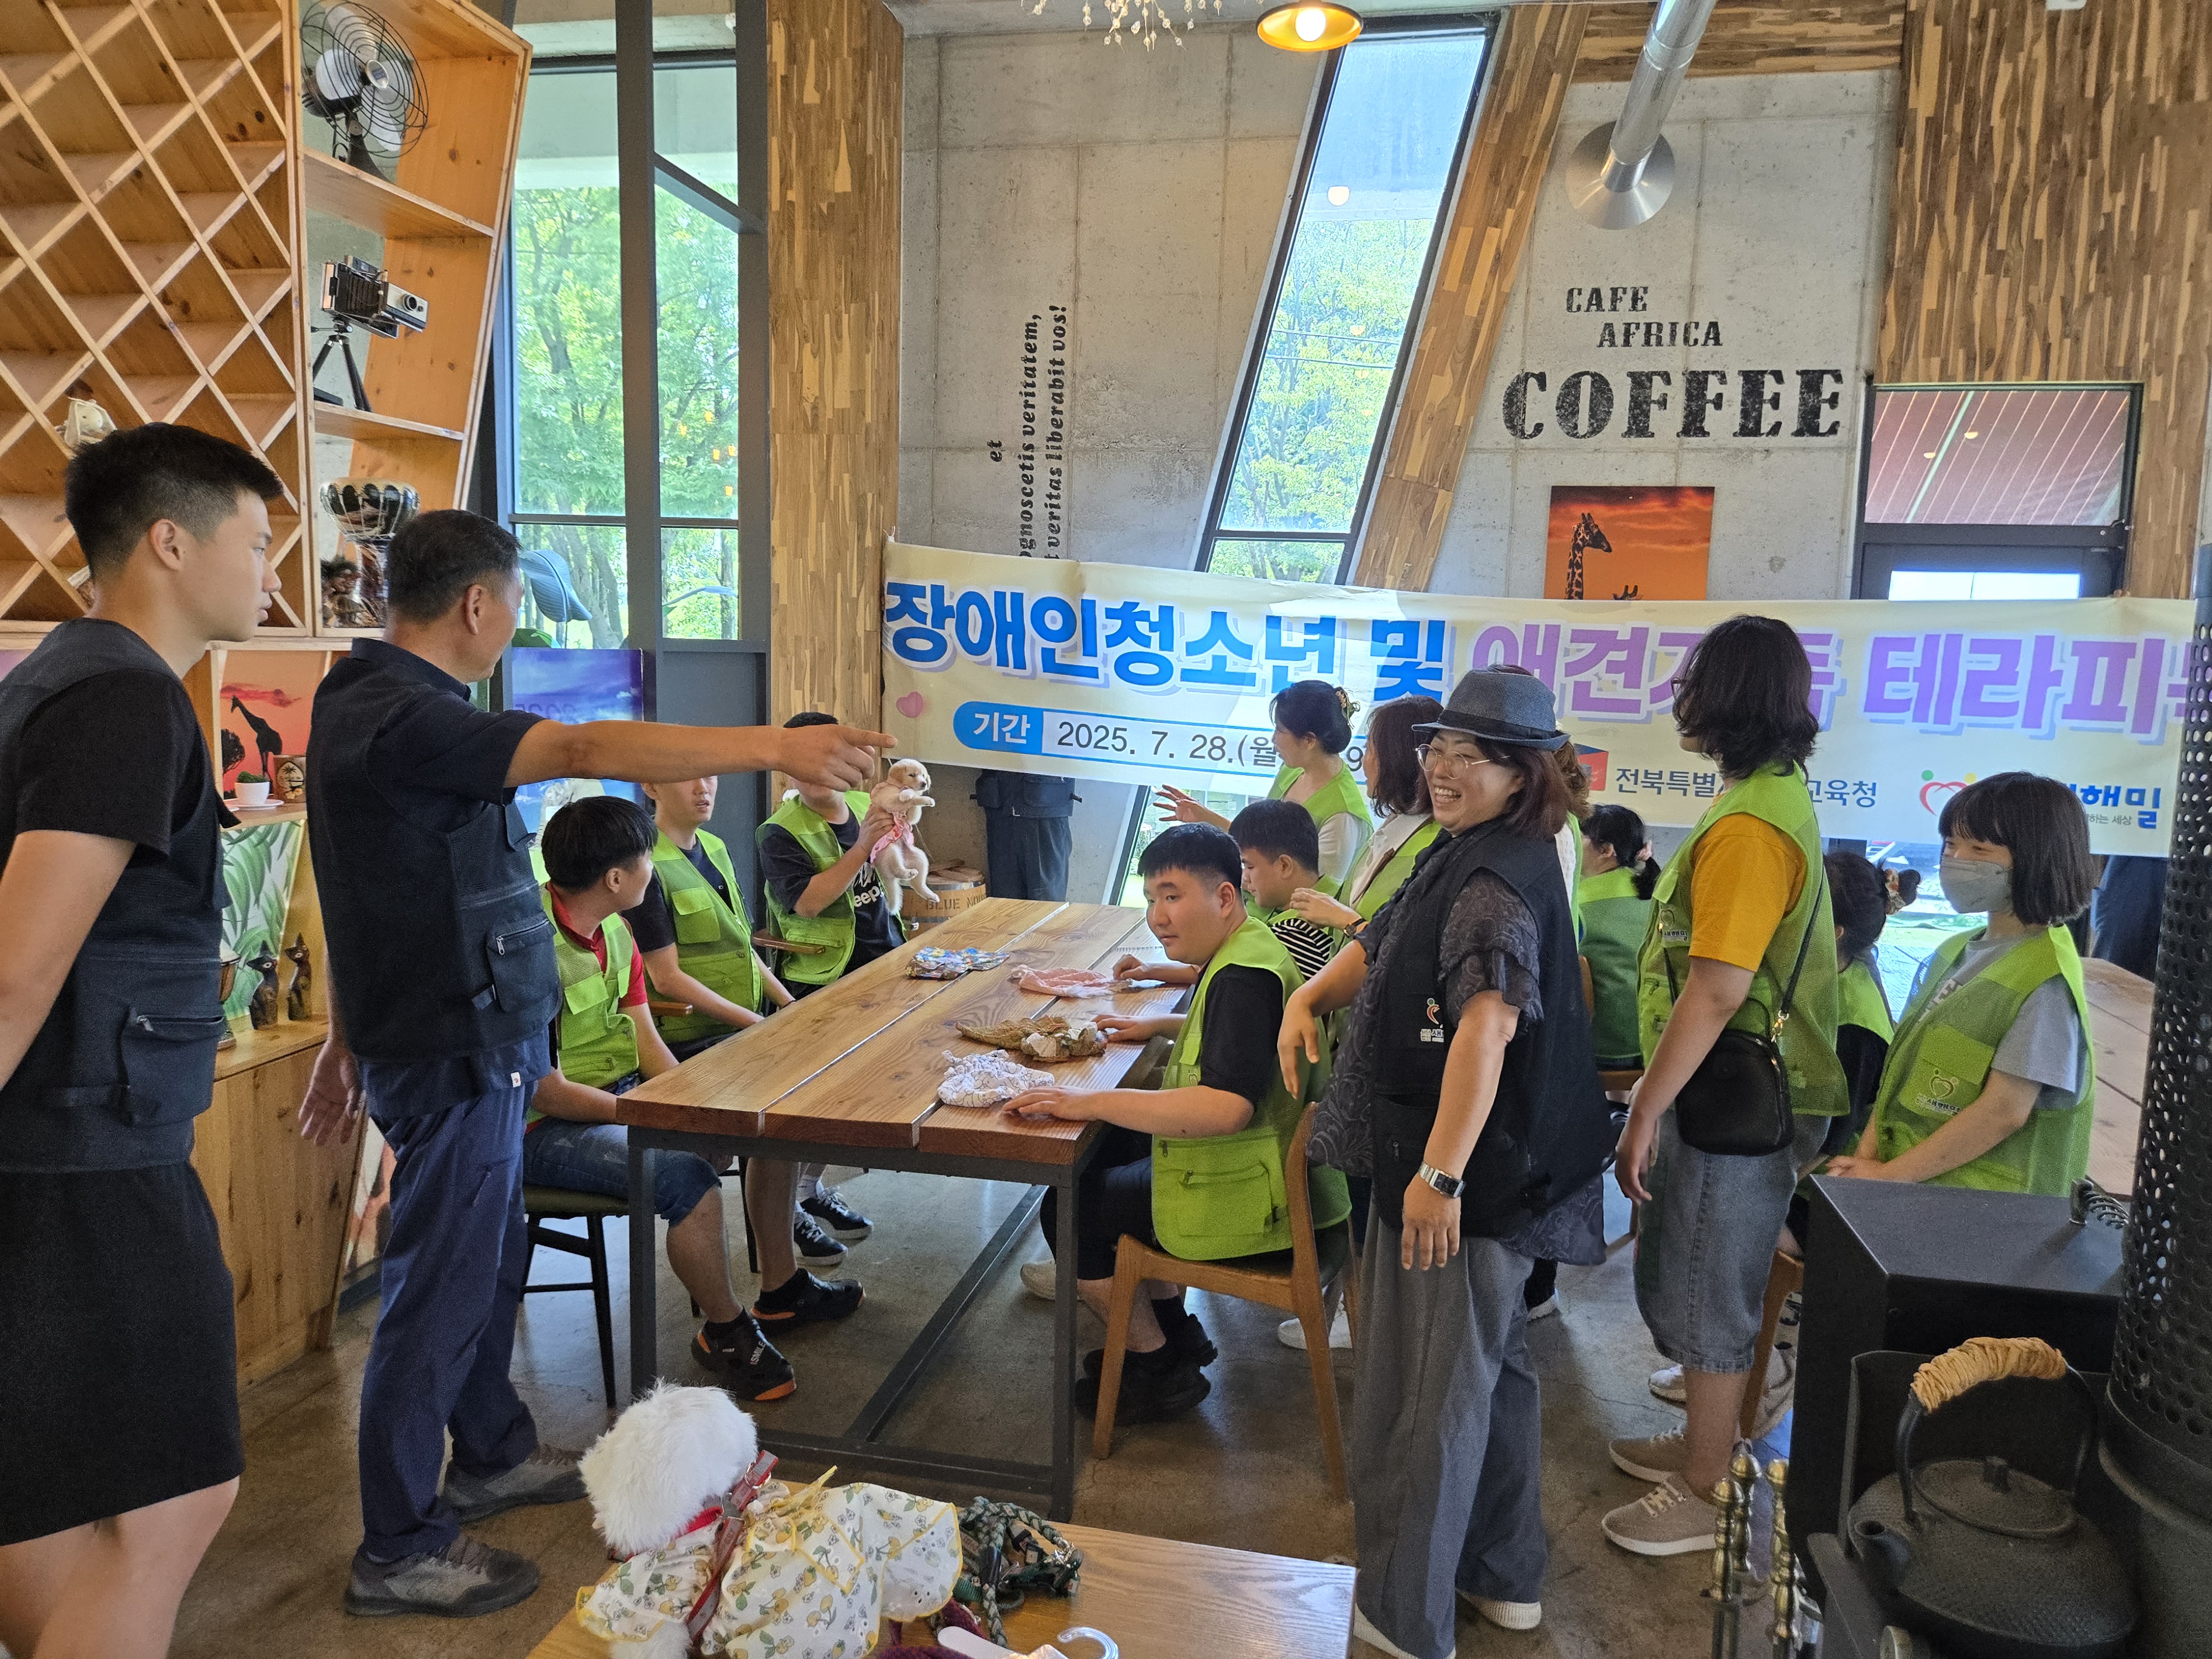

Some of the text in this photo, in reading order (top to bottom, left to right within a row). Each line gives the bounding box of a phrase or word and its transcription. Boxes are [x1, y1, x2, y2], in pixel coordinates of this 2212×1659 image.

[1566, 286, 1648, 312] CAFE
[1048, 305, 1067, 352] vos!
[1597, 321, 1723, 347] AFRICA
[1019, 314, 1042, 437] veritatem,
[1045, 357, 1065, 461] liberabit
[1502, 369, 1844, 439] COFFEE
[987, 440, 1003, 462] et
[1044, 467, 1062, 547] veritas
[886, 582, 1336, 693] 장애인청소년
[1369, 619, 1447, 701] 및
[1471, 624, 1834, 724] 애견
[973, 712, 1031, 744] 기간
[1058, 721, 1136, 755] 2025.
[1152, 731, 1175, 759] 7.
[1190, 734, 1284, 768] 28.(월
[854, 885, 880, 907] eep
[926, 898, 961, 910] BLUE
